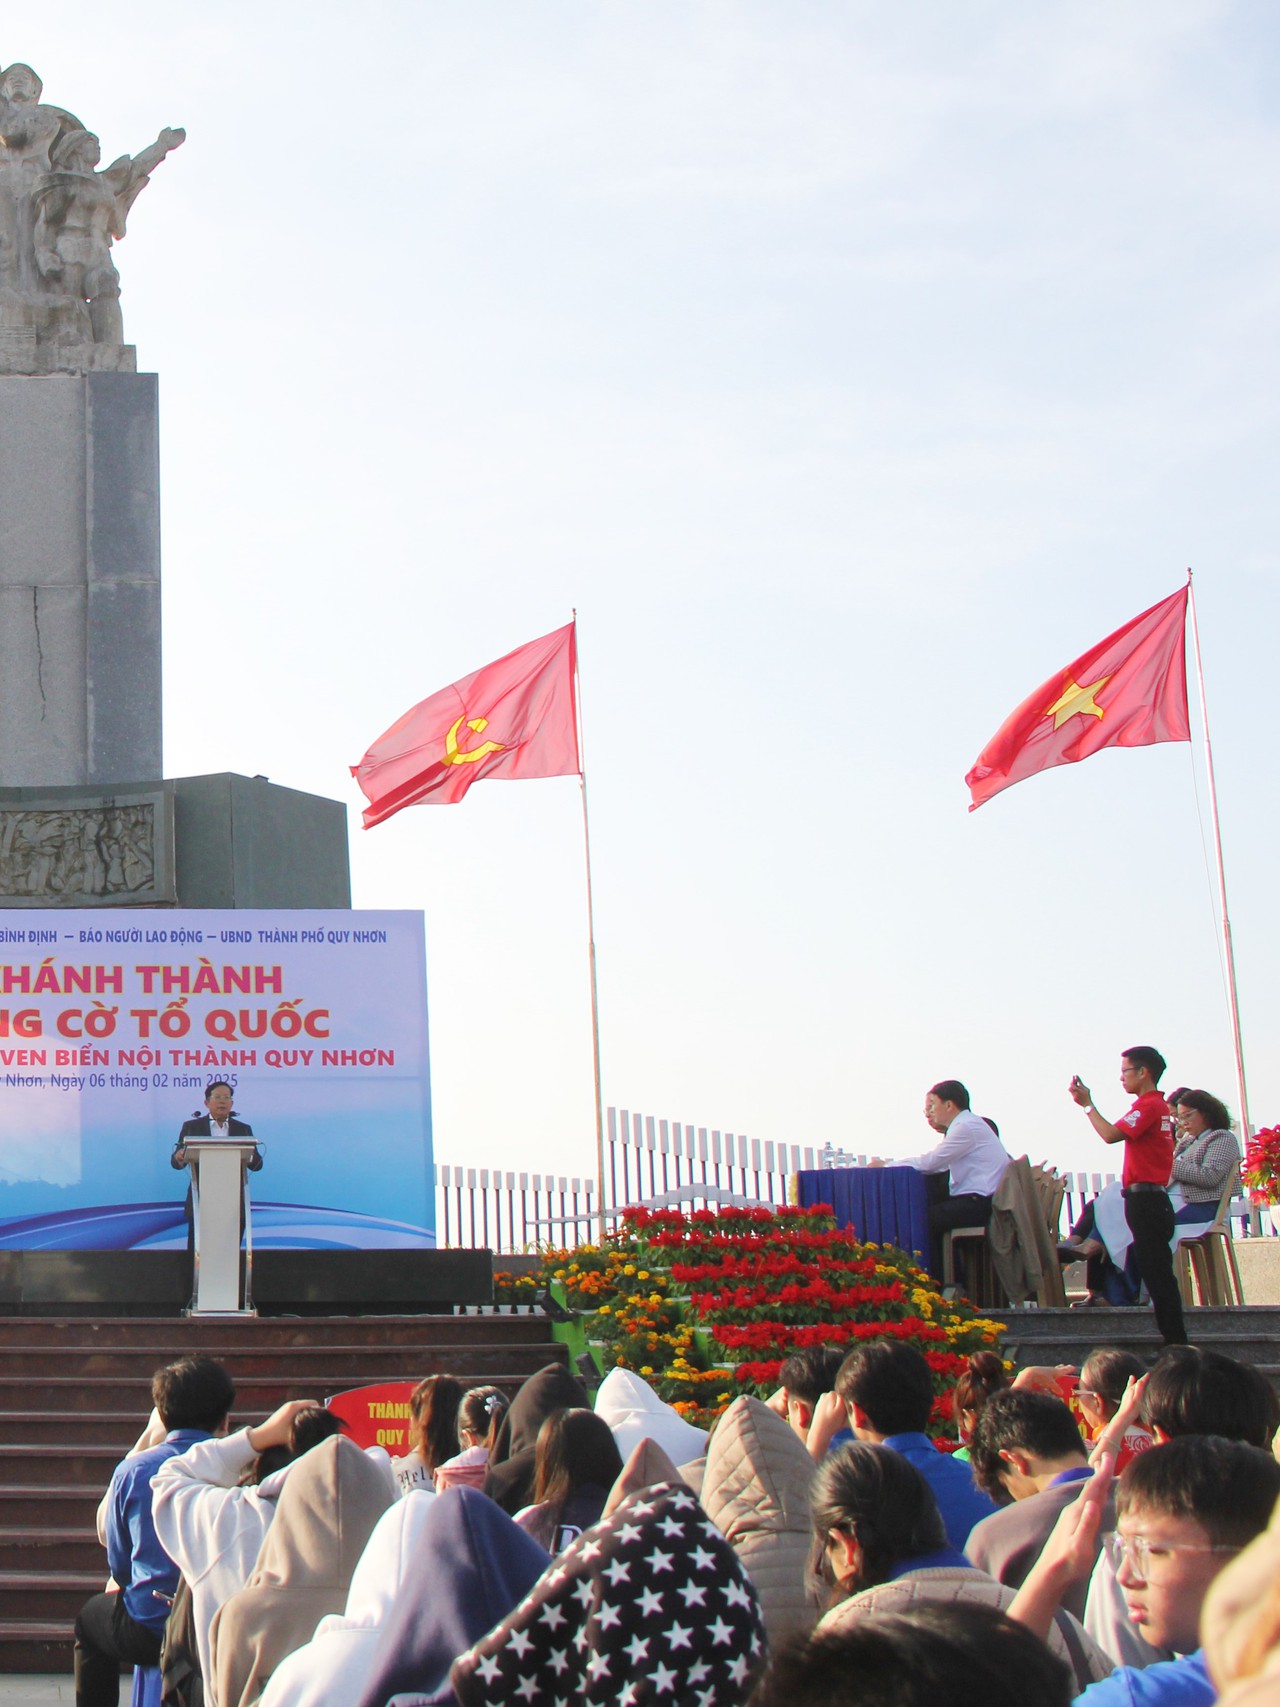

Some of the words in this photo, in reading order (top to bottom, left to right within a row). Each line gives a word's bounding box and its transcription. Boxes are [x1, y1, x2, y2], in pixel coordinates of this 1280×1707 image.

[28, 930, 58, 946] ĐỊNH
[79, 928, 103, 943] BÁO
[105, 928, 143, 943] NGƯỜI
[145, 930, 168, 943] LAO
[170, 928, 203, 946] ĐỘNG
[220, 930, 253, 943] UBND
[258, 928, 299, 943] THÀNH
[301, 927, 325, 943] PHỐ
[327, 930, 350, 944] QUY
[353, 930, 387, 943] NHƠN
[135, 956, 282, 994] THÀNH
[56, 1000, 119, 1038] CỜ
[130, 997, 191, 1038] TỔ
[204, 998, 330, 1042] QUỐC
[0, 1049, 46, 1066] VEN
[55, 1043, 109, 1066] BIỂN
[118, 1045, 161, 1070] NỘI
[169, 1045, 256, 1066] THÀNH
[264, 1049, 314, 1068] QUY
[321, 1048, 394, 1066] NHƠN
[5, 1073, 45, 1089] Nhơn,
[51, 1074, 85, 1091] Ngày
[89, 1073, 106, 1088] 06
[109, 1073, 149, 1091] tháng
[152, 1073, 169, 1088] 02
[173, 1074, 202, 1088] năm
[376, 1429, 404, 1447] QUY
